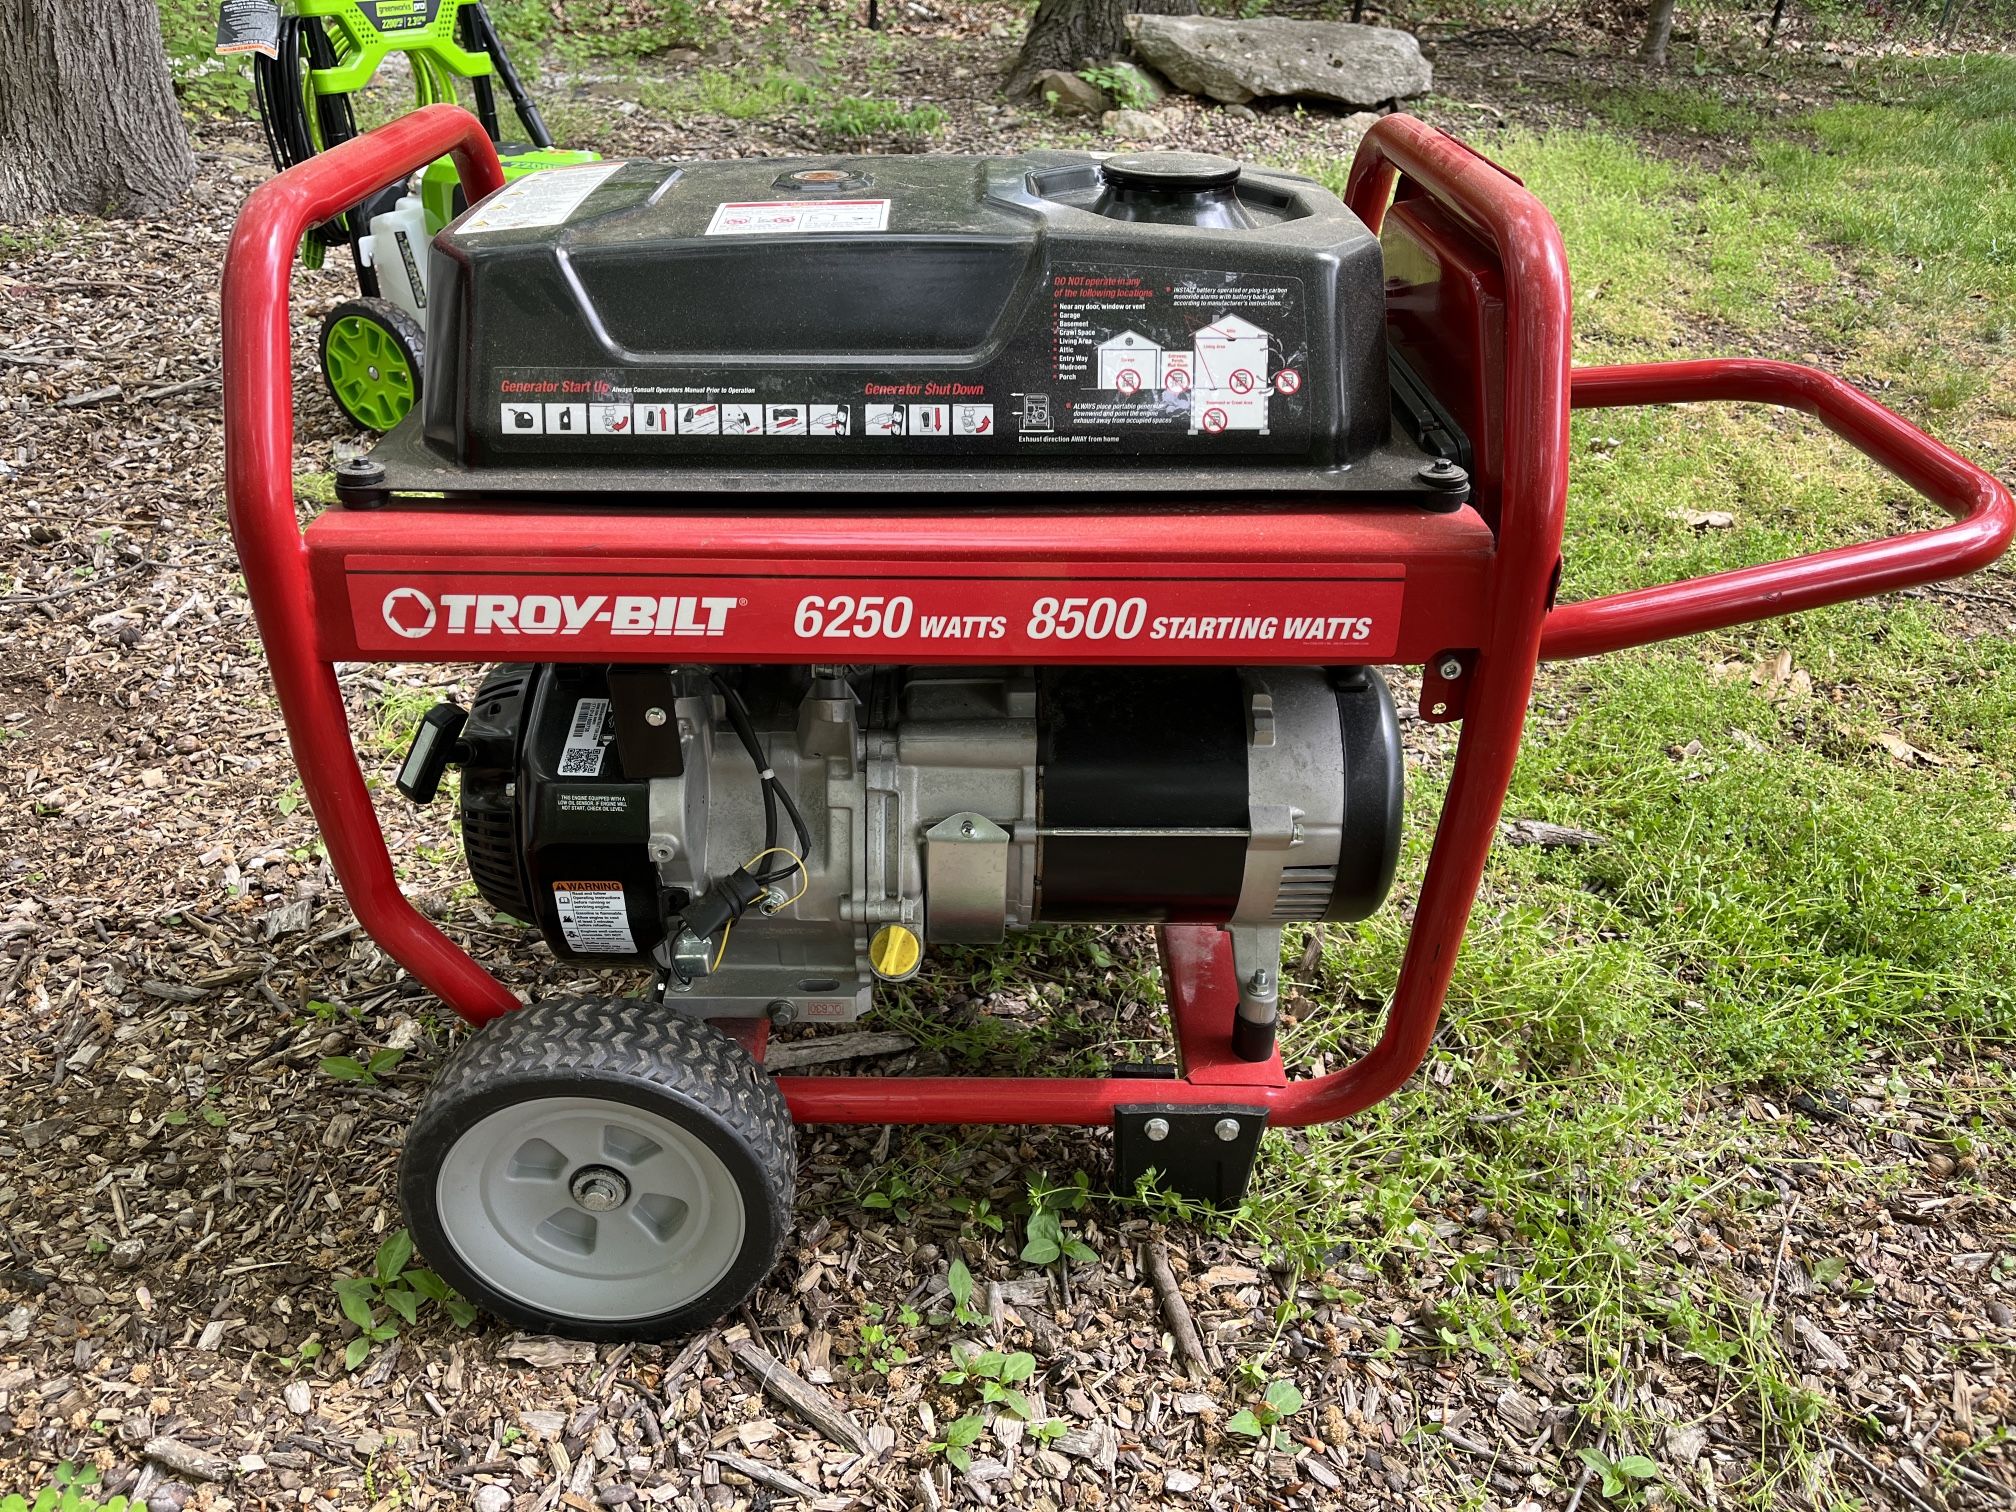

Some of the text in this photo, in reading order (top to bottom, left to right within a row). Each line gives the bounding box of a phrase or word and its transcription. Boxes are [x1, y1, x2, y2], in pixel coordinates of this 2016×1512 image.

[378, 3, 425, 14] greenworks pro
[1054, 277, 1141, 288] DO NOT operate in any
[1054, 288, 1153, 298] of the following locations
[1085, 303, 1100, 311] door,
[1080, 329, 1096, 337] Space
[1059, 338, 1078, 346] Living
[1059, 355, 1075, 363] Entry
[501, 380, 559, 393] Generator
[561, 380, 592, 393] Start
[594, 380, 609, 394] Up
[864, 382, 984, 395] Generator Shut Down
[1073, 402, 1096, 410] ALWAYS
[1096, 403, 1112, 411] place
[1112, 403, 1137, 411] portable
[1018, 435, 1043, 443] Exhaust
[1043, 435, 1070, 443] direction
[1088, 435, 1102, 443] from
[793, 595, 913, 639] 6250
[919, 615, 1007, 639] WATTS
[1026, 596, 1148, 640] 8500
[1149, 616, 1276, 640] STARTING
[1282, 616, 1372, 641] WATTS
[566, 882, 620, 891] WARNING
